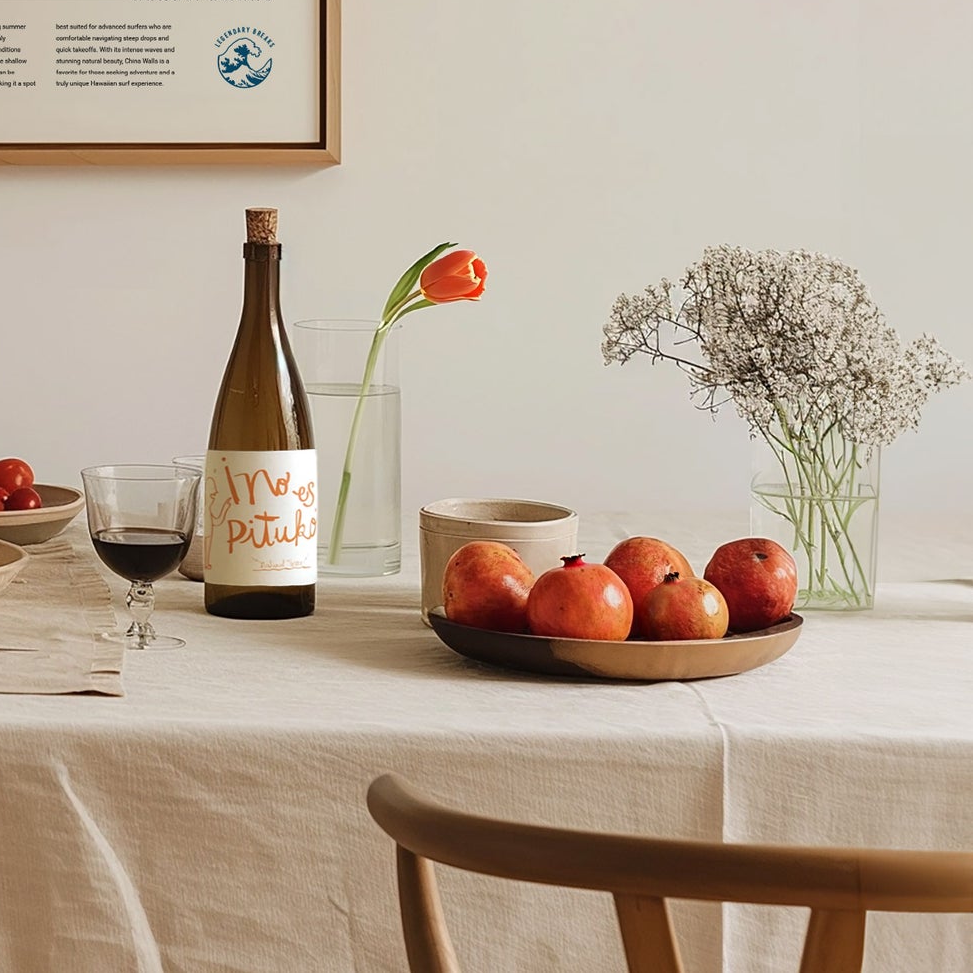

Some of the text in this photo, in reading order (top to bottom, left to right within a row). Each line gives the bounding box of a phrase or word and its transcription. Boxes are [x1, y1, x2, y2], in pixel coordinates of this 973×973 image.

[92, 35, 122, 43] navigating
[123, 35, 139, 43] steep
[140, 35, 157, 43] drops
[214, 26, 276, 48] LEGENDARY BREAKS
[56, 46, 71, 54] quick
[23, 80, 36, 88] spot
[56, 80, 68, 88] truly
[70, 80, 89, 88] unique
